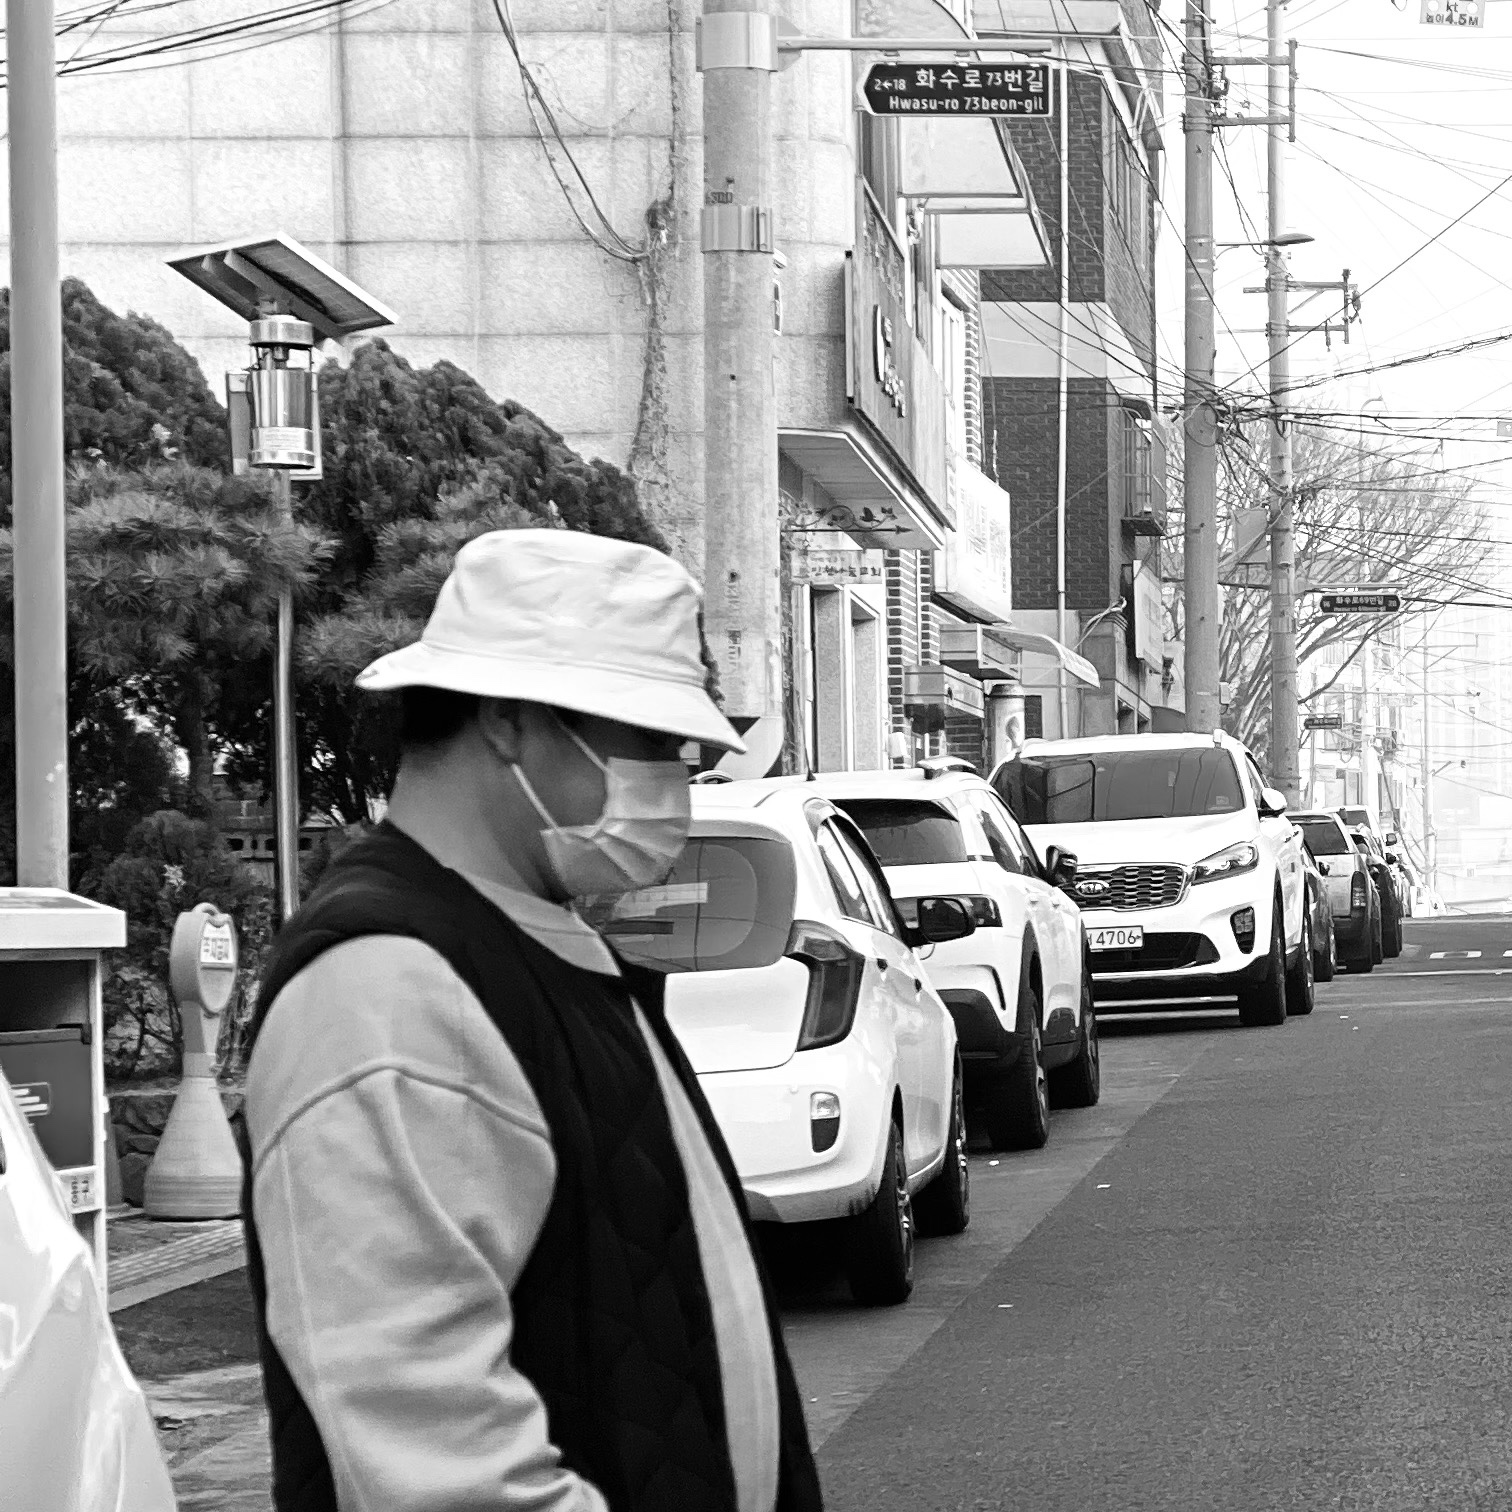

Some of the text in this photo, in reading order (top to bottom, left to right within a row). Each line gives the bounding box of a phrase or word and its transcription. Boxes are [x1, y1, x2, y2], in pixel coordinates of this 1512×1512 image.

[888, 95, 1045, 114] Hwasu-ro 73beon-gil
[1095, 930, 1137, 945] 4706
